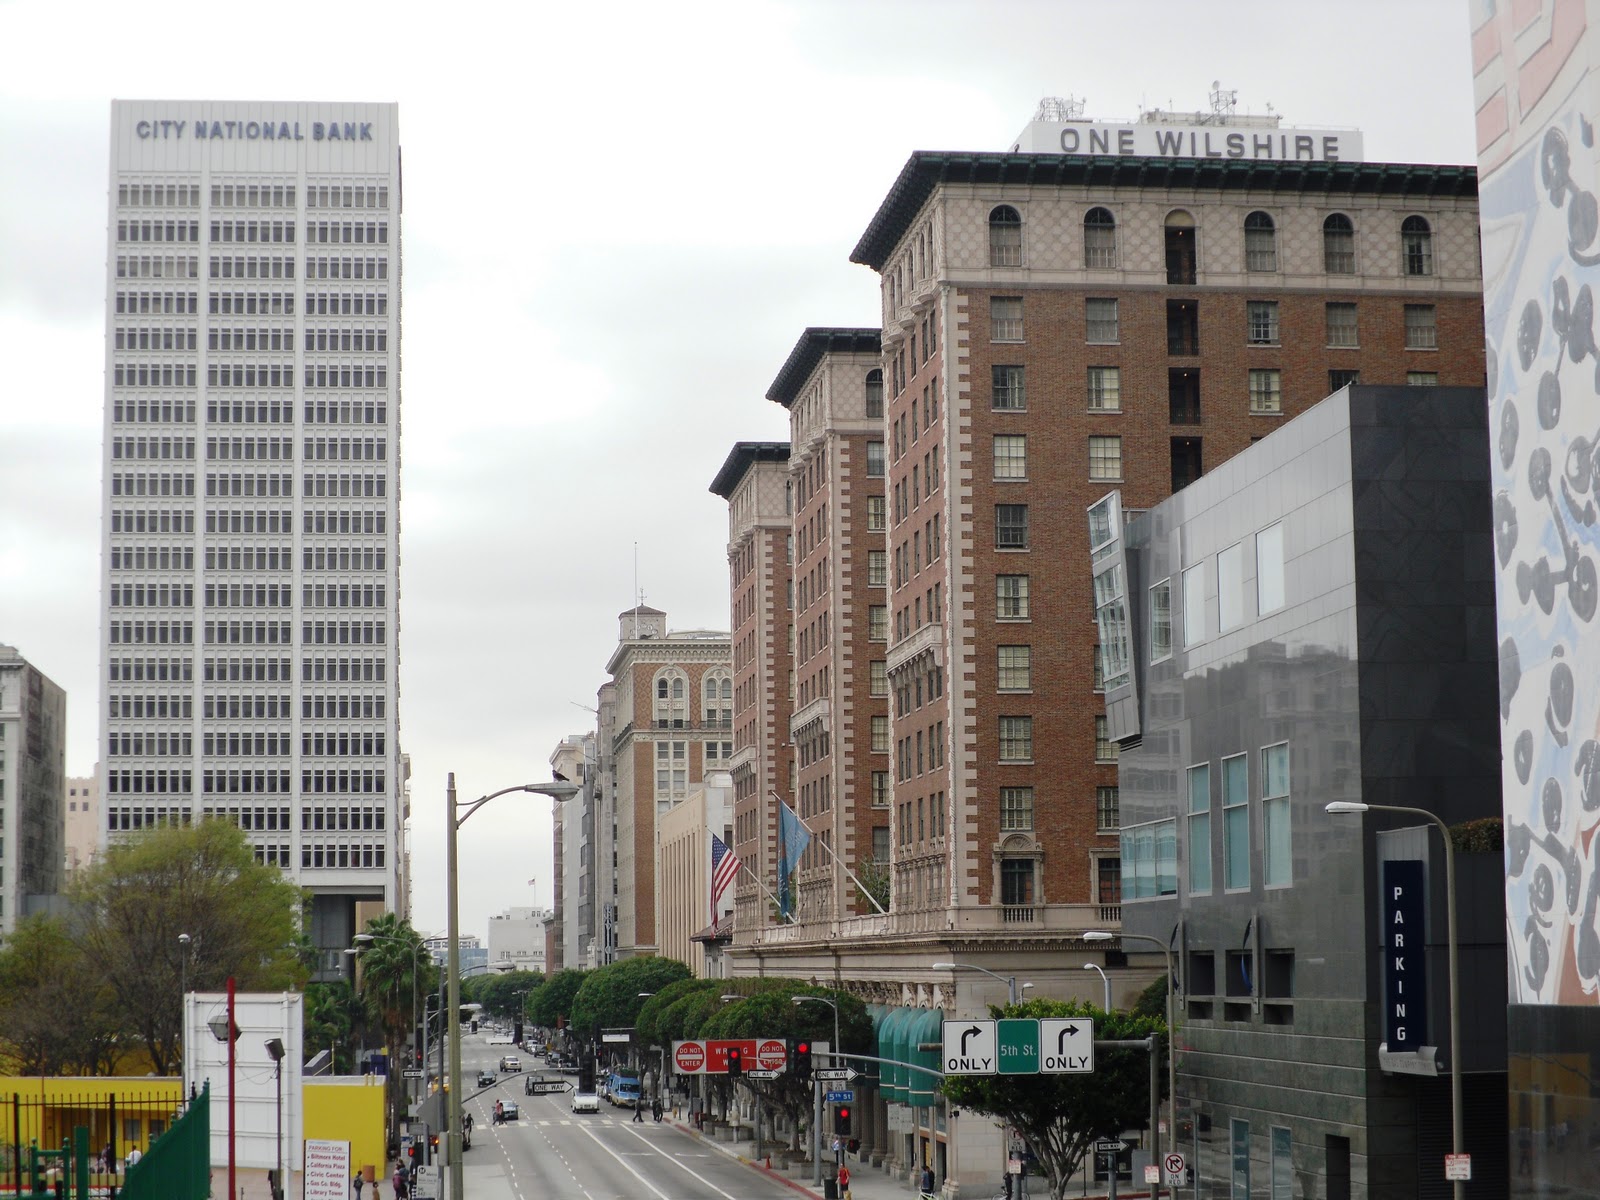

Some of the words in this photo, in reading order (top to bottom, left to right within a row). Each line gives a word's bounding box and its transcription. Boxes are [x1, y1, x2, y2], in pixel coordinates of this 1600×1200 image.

[136, 120, 186, 139] CITY
[195, 120, 304, 140] NATIONAL
[312, 122, 373, 141] BANK
[1060, 128, 1134, 154] ONE
[1155, 130, 1339, 161] WILSHIRE
[1394, 886, 1406, 1041] PARKING
[1001, 1045, 1018, 1056] 5th
[1023, 1044, 1037, 1056] St.
[948, 1058, 992, 1070] ONLY
[1046, 1057, 1089, 1069] ONLY
[310, 1189, 328, 1197] Library
